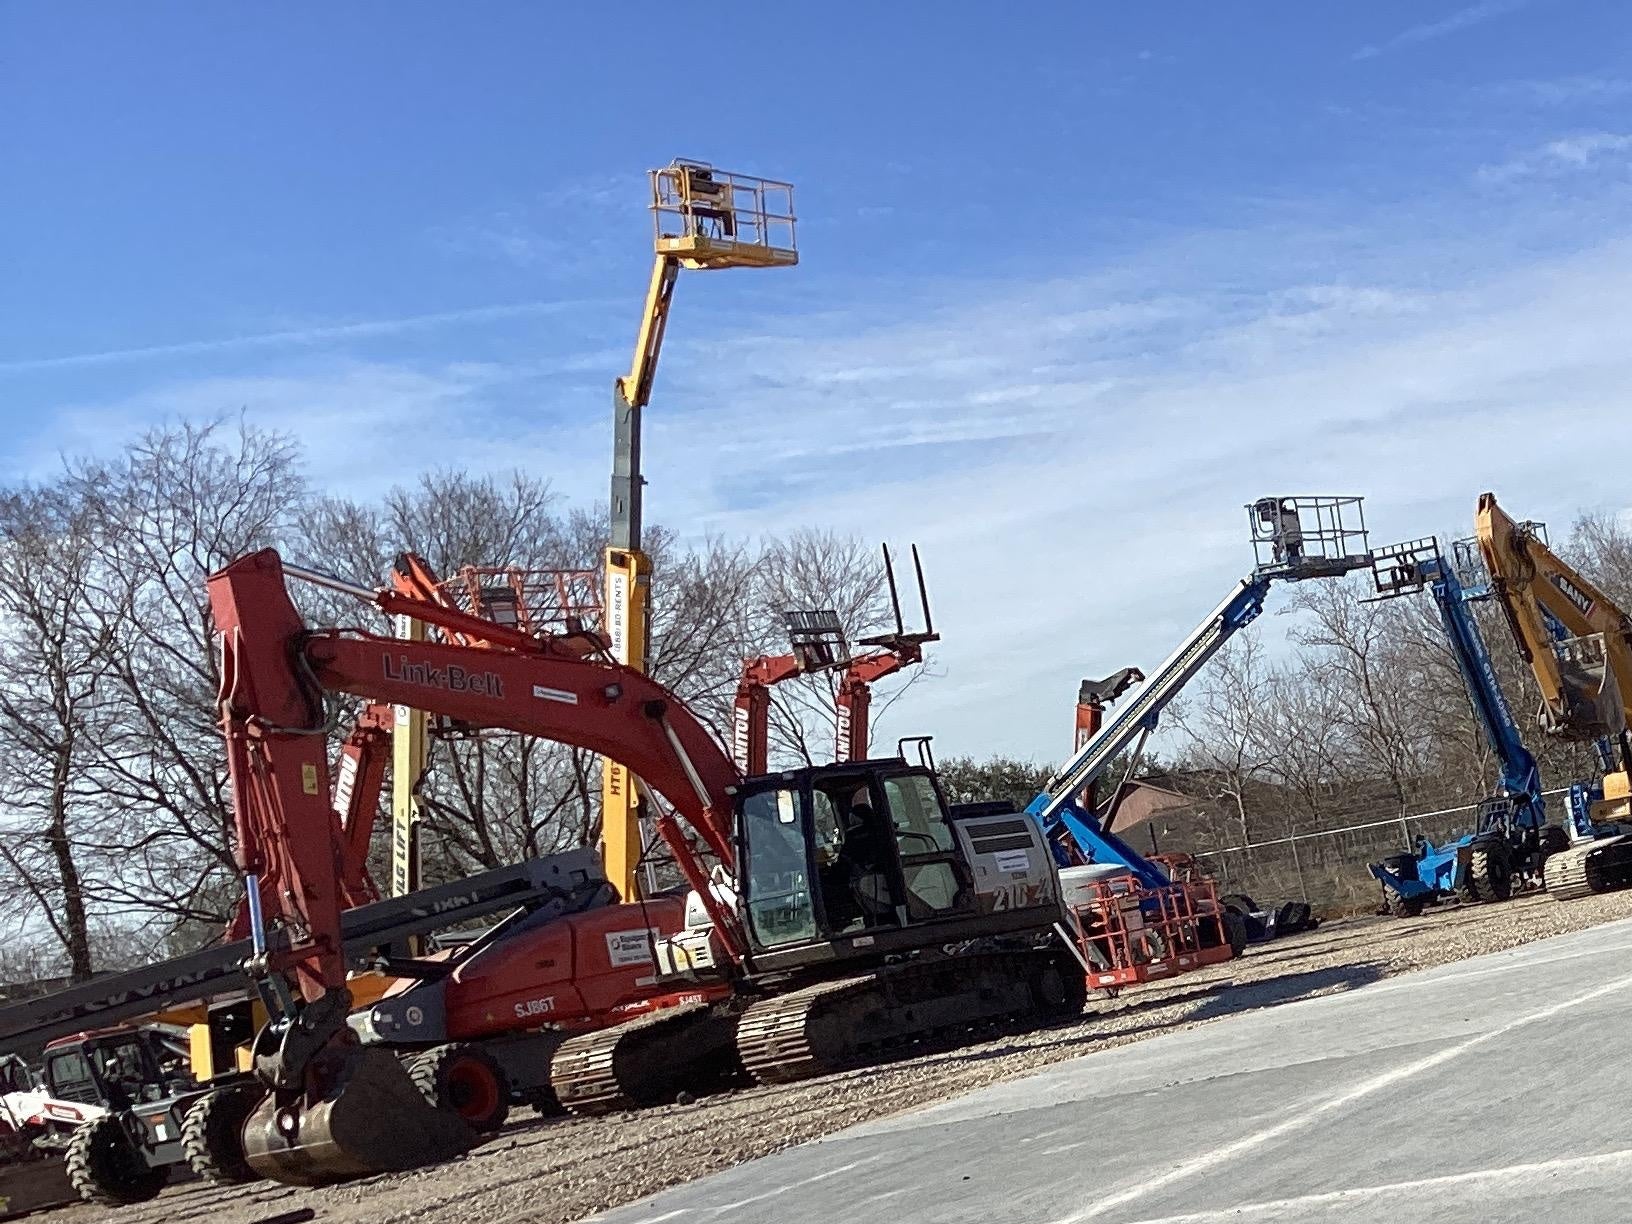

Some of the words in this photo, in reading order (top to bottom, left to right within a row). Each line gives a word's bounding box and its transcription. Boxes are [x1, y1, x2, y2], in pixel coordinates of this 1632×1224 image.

[382, 654, 504, 698] Link-Belt
[734, 707, 750, 777] ANITOU
[610, 761, 622, 797] HT6
